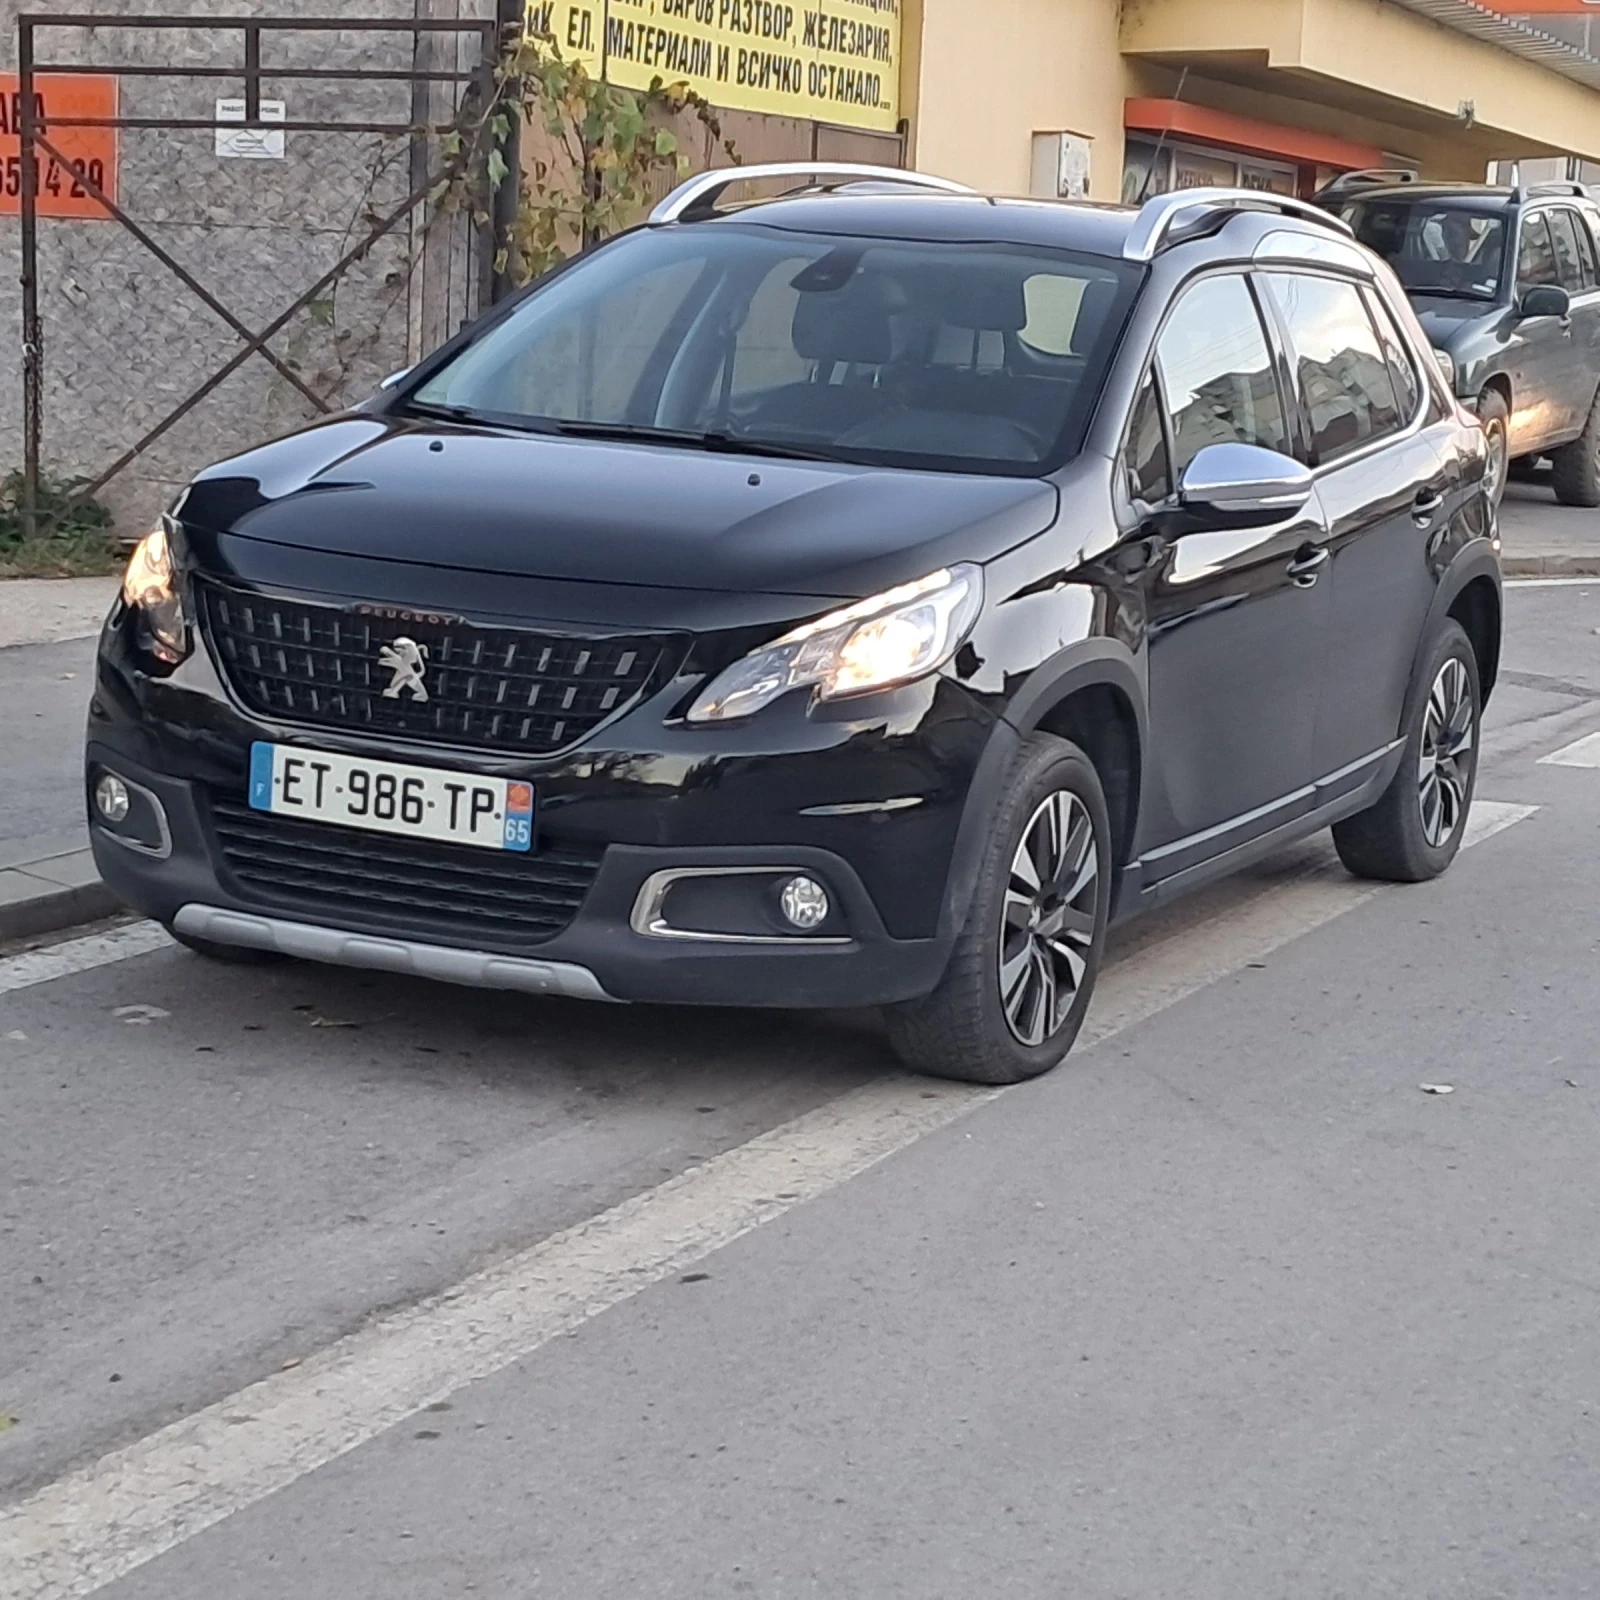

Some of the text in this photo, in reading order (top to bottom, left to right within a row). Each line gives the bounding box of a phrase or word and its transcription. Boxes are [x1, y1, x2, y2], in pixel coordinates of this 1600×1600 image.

[567, 6, 595, 52] ЕЛ.
[607, 16, 712, 78] МАТЕРИАЛИ
[716, 44, 730, 82] И
[736, 48, 801, 94] ВСИЧКО
[718, 0, 797, 48] РАЗТВОР,
[802, 10, 893, 67] ЖЕЛЕЗАРИЯ,
[0, 157, 20, 197] 5
[70, 158, 103, 198] 29
[359, 605, 453, 625] PEUGEOT
[505, 818, 529, 843] 65
